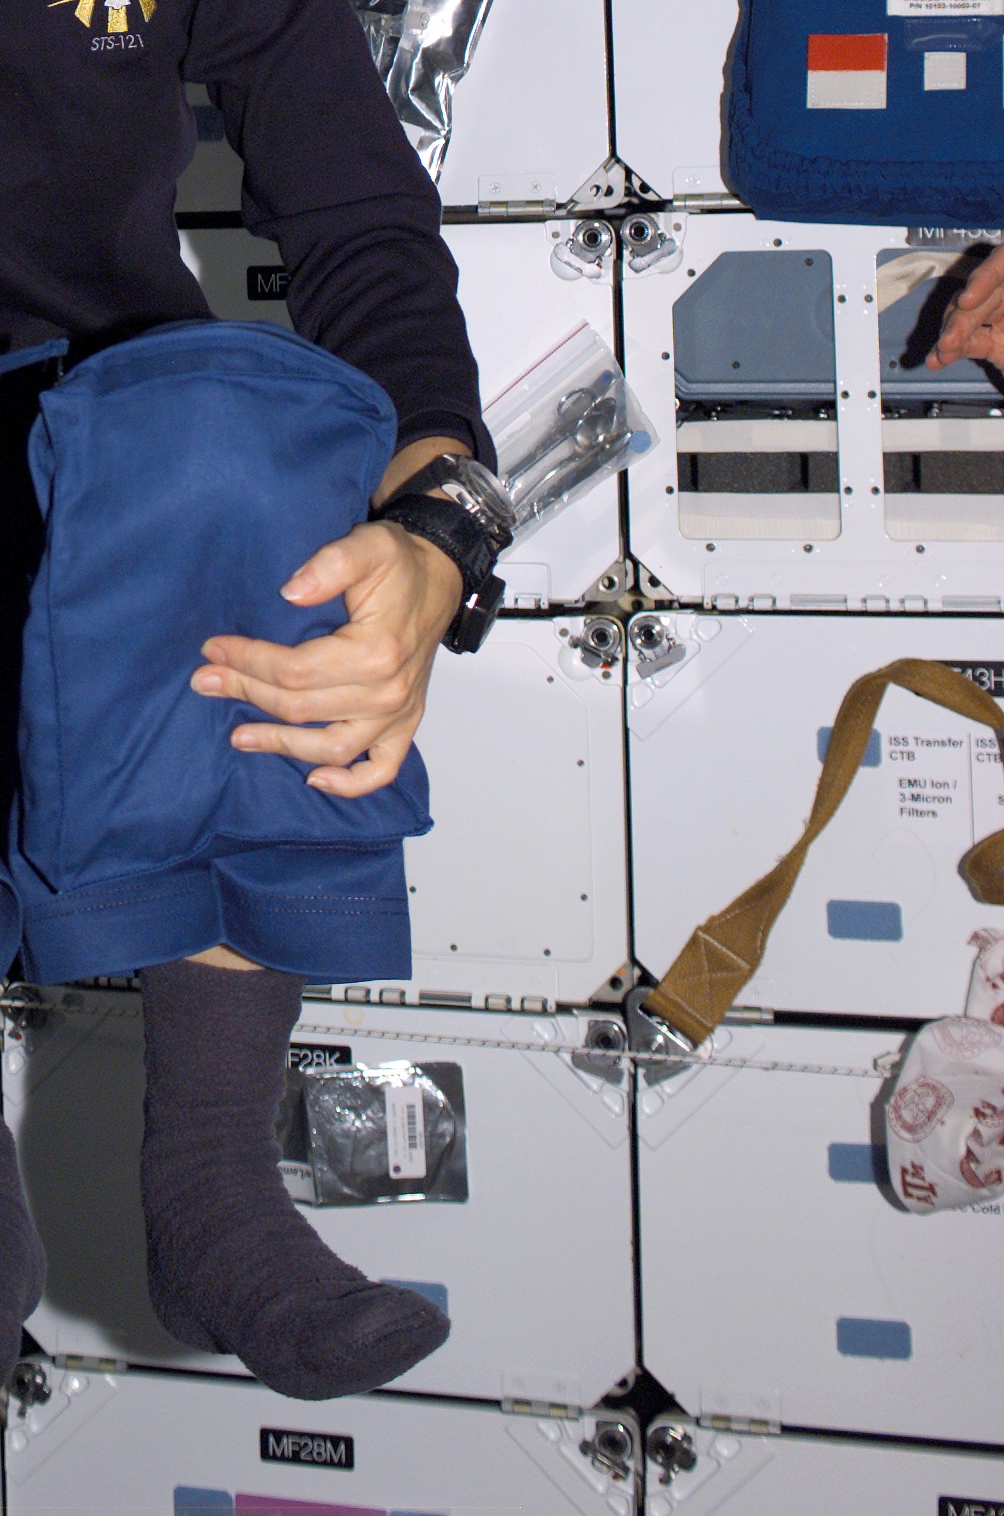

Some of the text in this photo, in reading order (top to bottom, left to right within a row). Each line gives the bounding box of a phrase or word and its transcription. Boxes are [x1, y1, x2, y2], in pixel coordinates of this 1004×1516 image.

[90, 34, 144, 51] STS-121
[257, 273, 288, 293] MF
[889, 737, 965, 748] ISS Transfer
[975, 738, 996, 748] ISS
[889, 750, 916, 762] CTB
[898, 778, 927, 790] EMU
[931, 779, 950, 790] Ion
[899, 793, 952, 804] 3-Micron
[900, 807, 938, 818] Filters
[287, 1049, 340, 1069] F28K
[972, 1204, 1001, 1215] Cold
[268, 1433, 346, 1465] MF28M
